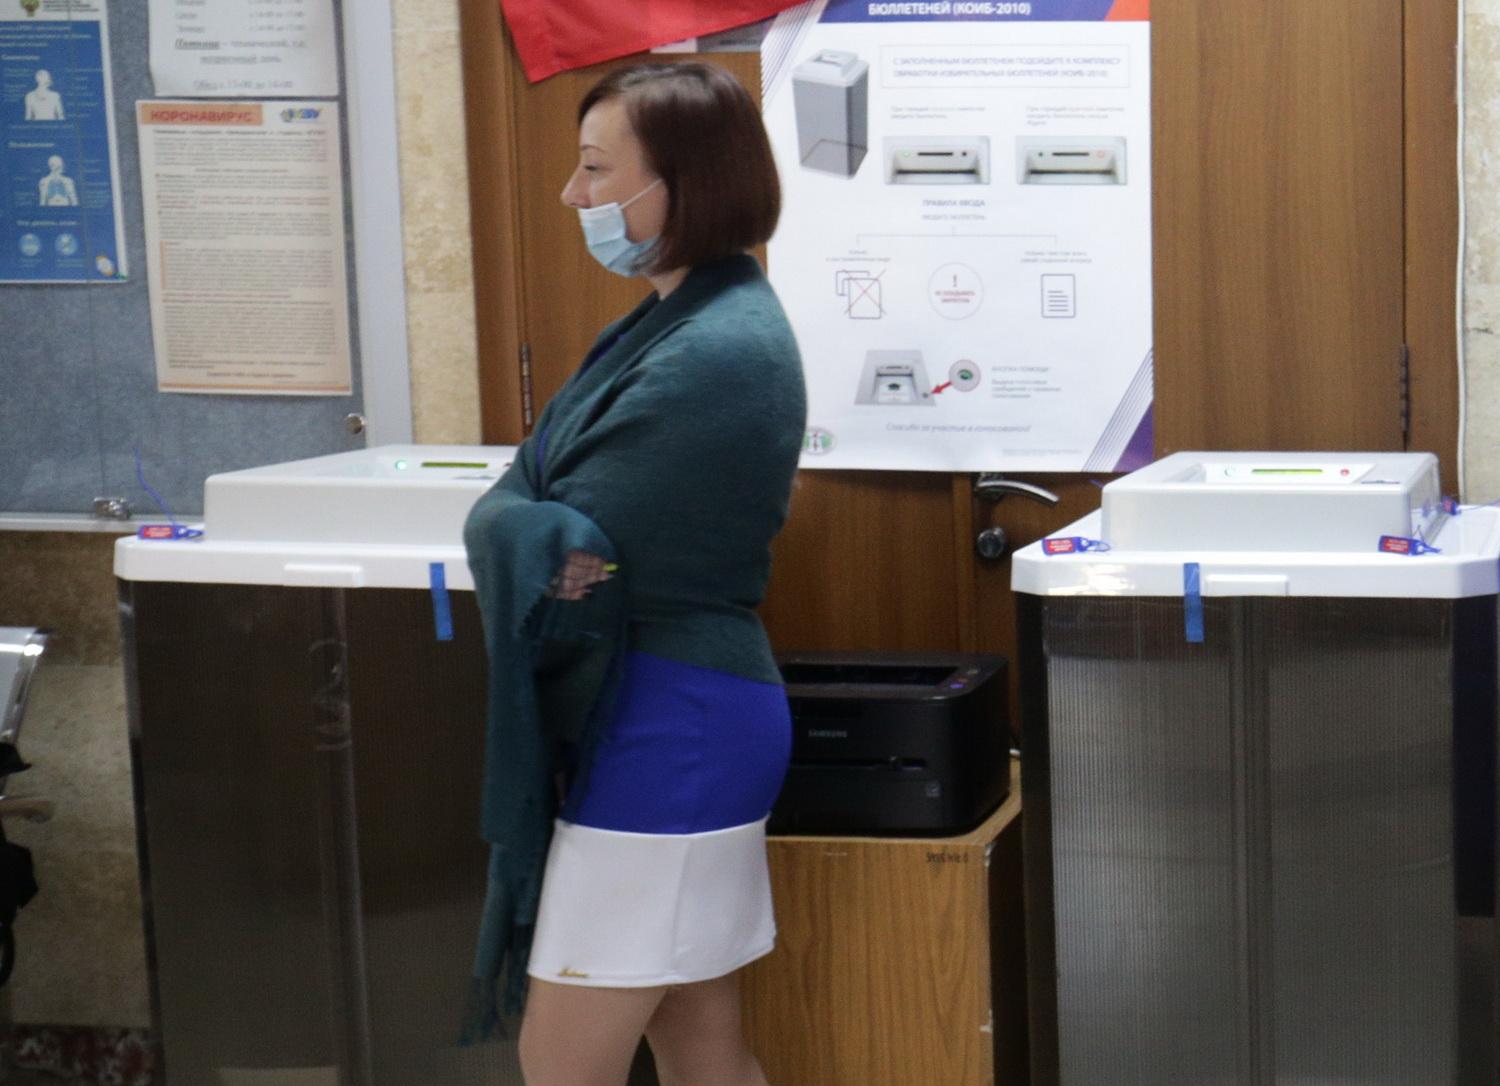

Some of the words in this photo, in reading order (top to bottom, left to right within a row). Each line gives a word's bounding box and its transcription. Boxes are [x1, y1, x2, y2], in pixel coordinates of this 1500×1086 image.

[868, 1, 951, 15] БЮЛЛЕТЕНЕЙ
[953, 2, 1031, 16] (КОИБ-2010)
[150, 110, 253, 122] КОРОНАВИРУС
[808, 729, 848, 738] SAMSUNG
